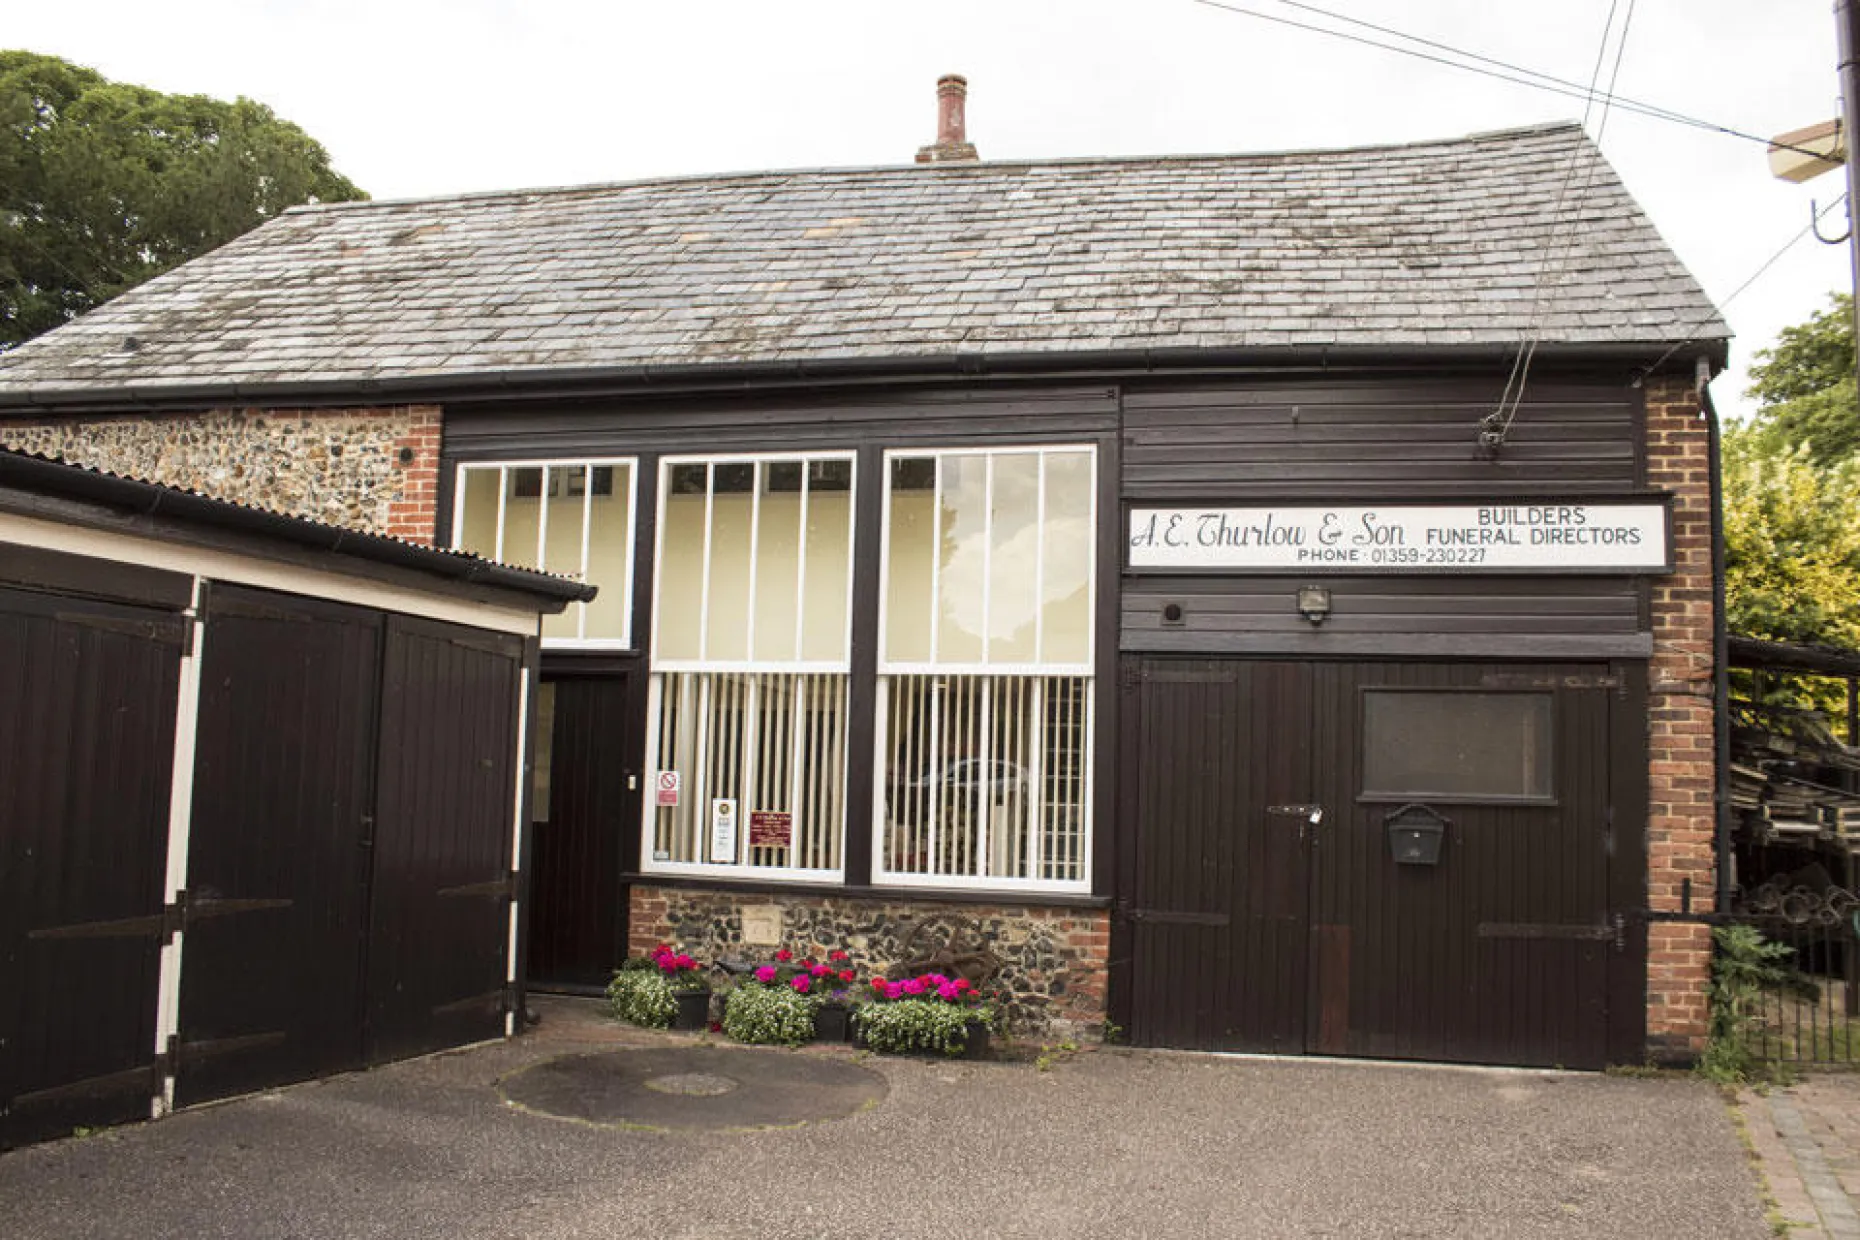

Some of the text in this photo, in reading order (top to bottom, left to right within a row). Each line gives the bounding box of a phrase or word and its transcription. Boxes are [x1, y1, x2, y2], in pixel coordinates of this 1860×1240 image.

[1478, 507, 1586, 526] BUILDERS
[1197, 512, 1306, 547] Thurlow
[1318, 512, 1343, 546] &
[1352, 512, 1405, 547] Son
[1427, 527, 1641, 545] FUNERAL DIRECTORS
[1371, 548, 1487, 563] 01359-230227
